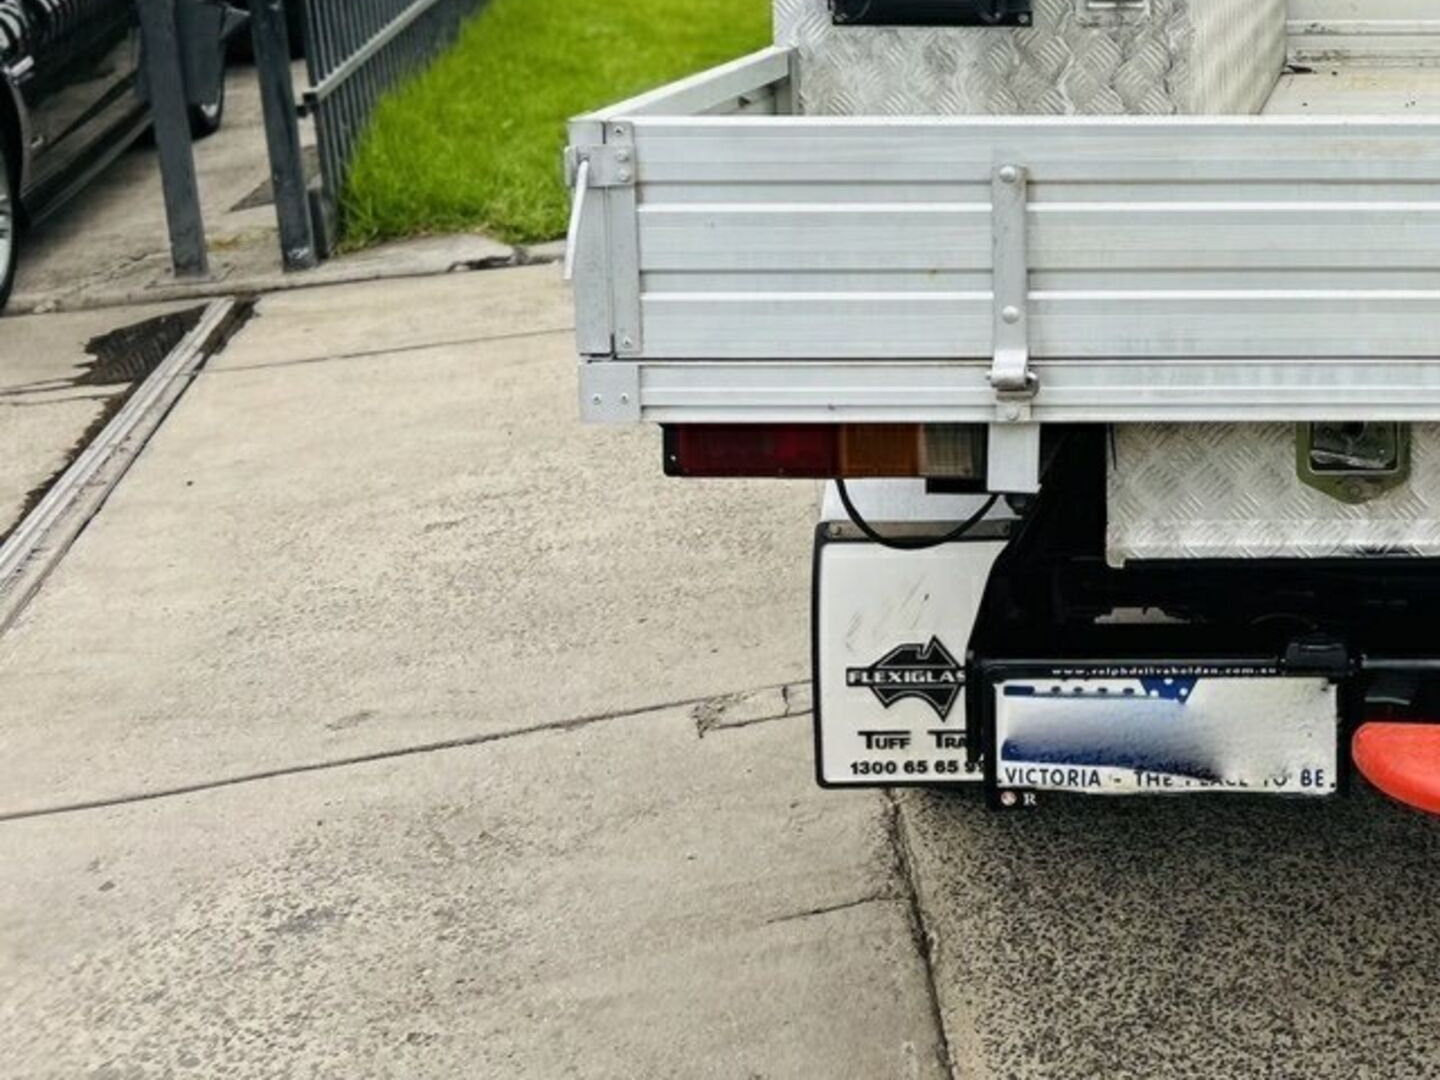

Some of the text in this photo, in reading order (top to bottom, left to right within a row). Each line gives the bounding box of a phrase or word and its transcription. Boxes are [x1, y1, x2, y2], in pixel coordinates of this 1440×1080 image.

[847, 670, 966, 683] FLEXIGLAS
[927, 729, 967, 749] TRA
[850, 760, 897, 775] 1300
[903, 760, 929, 775] 65
[934, 760, 960, 775] 65
[1004, 767, 1102, 788] VICTORIA
